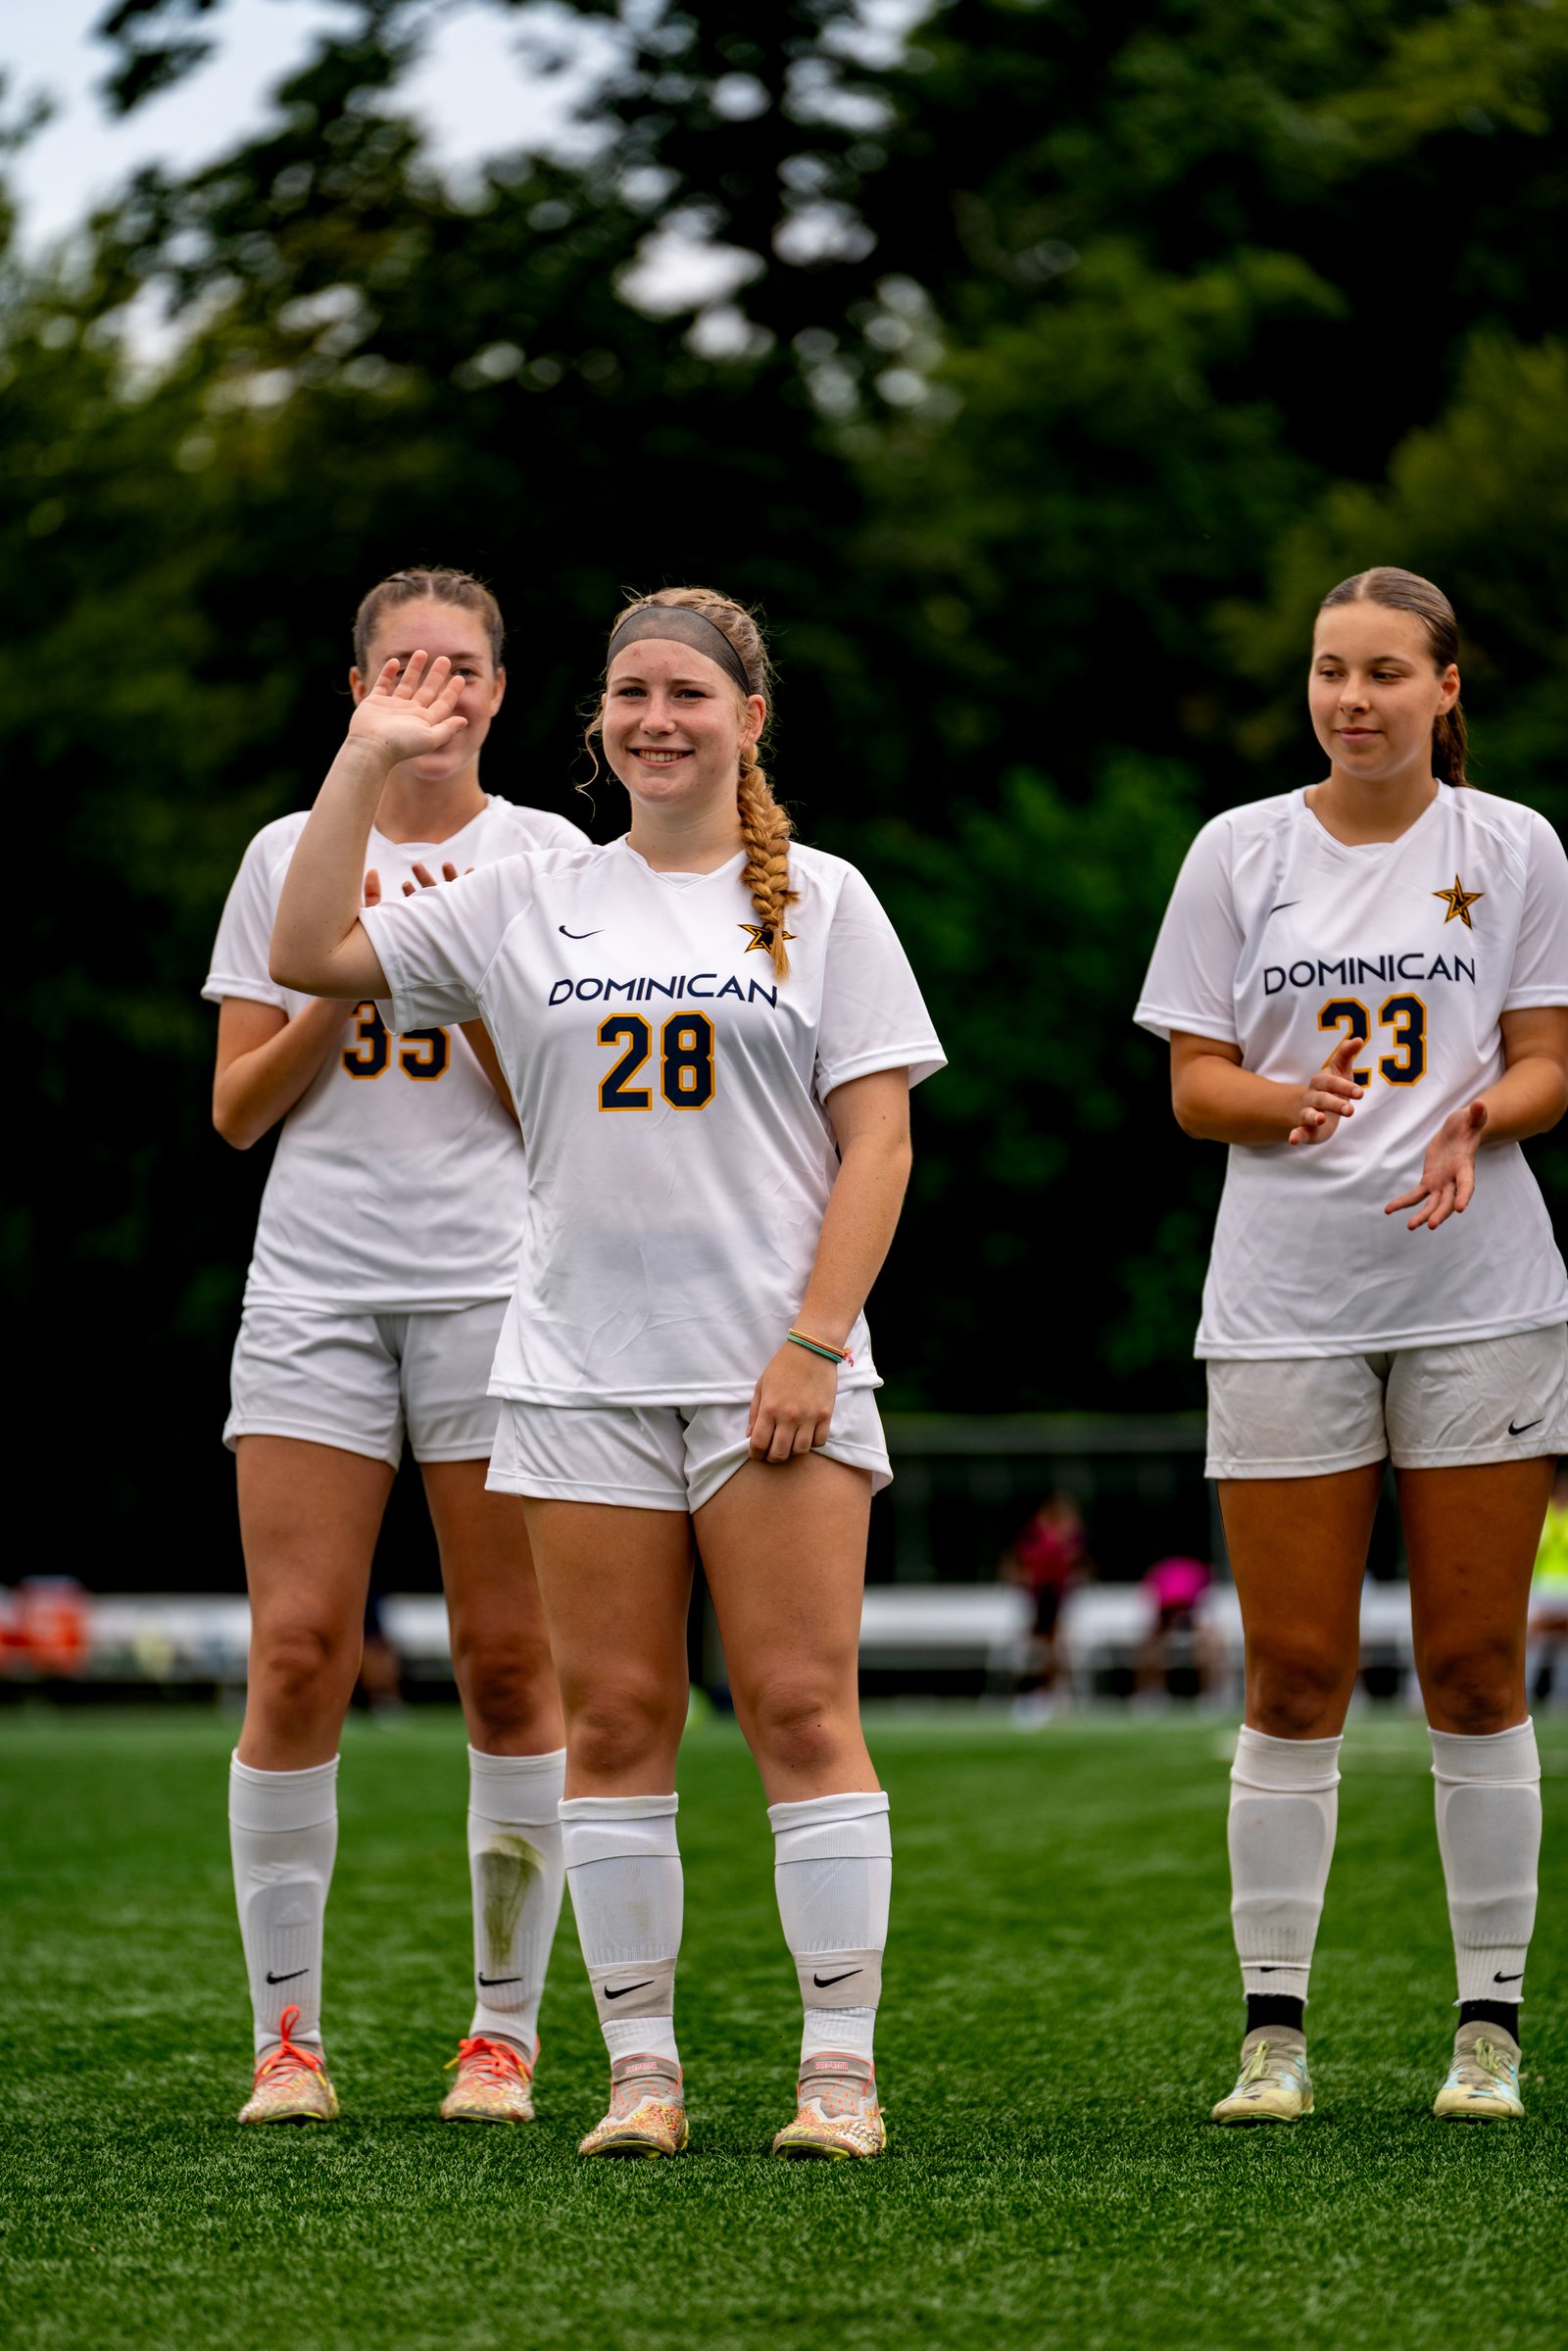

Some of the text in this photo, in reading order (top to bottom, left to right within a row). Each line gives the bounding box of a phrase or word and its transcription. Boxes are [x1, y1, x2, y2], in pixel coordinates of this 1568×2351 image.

[549, 973, 778, 1009] DOMINICAN
[1264, 953, 1476, 996] DOMINICAN
[342, 999, 451, 1082] 35
[597, 1009, 716, 1112] 28
[1317, 992, 1428, 1090] 23
